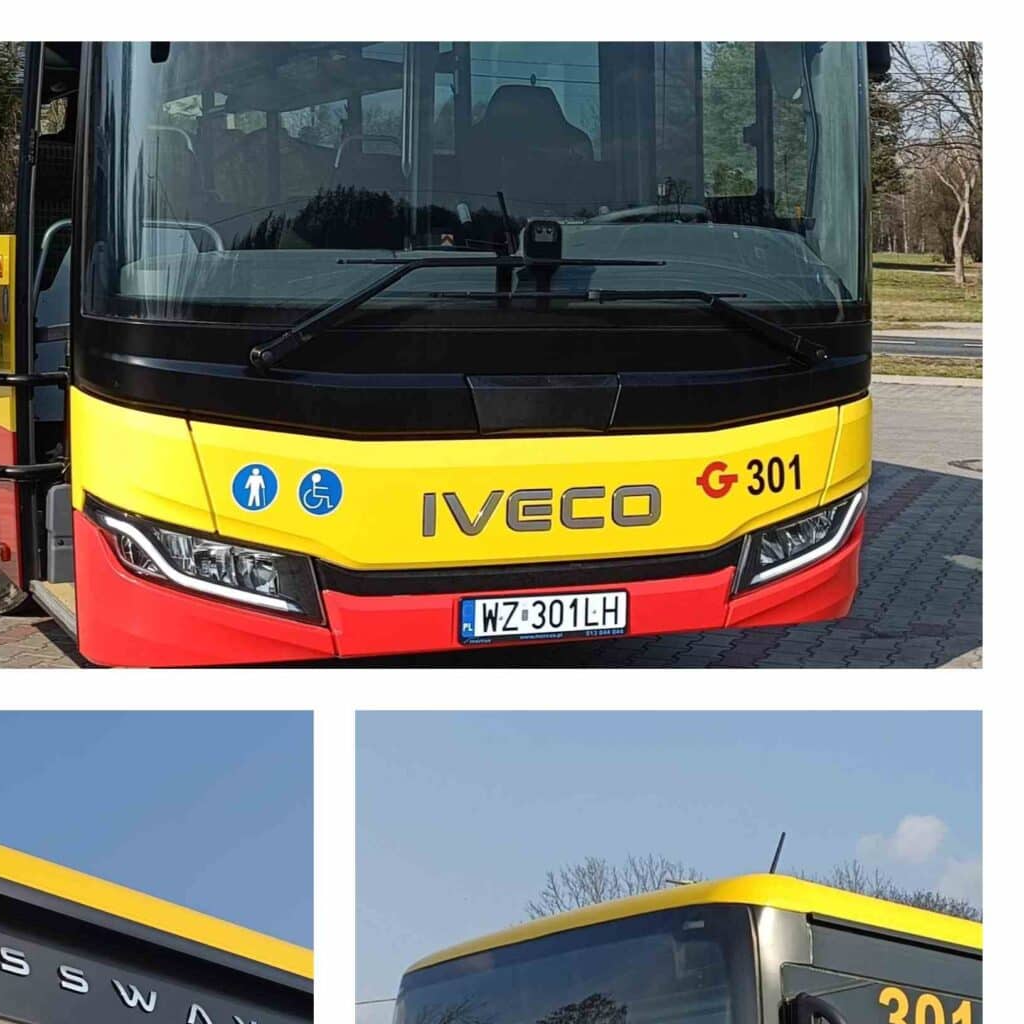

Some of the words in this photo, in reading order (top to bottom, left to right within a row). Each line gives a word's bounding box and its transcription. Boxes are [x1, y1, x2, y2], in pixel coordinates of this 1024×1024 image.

[747, 454, 801, 496] 301
[422, 484, 662, 537] IVECO
[482, 602, 519, 633] WZ
[531, 596, 619, 629] 301LH
